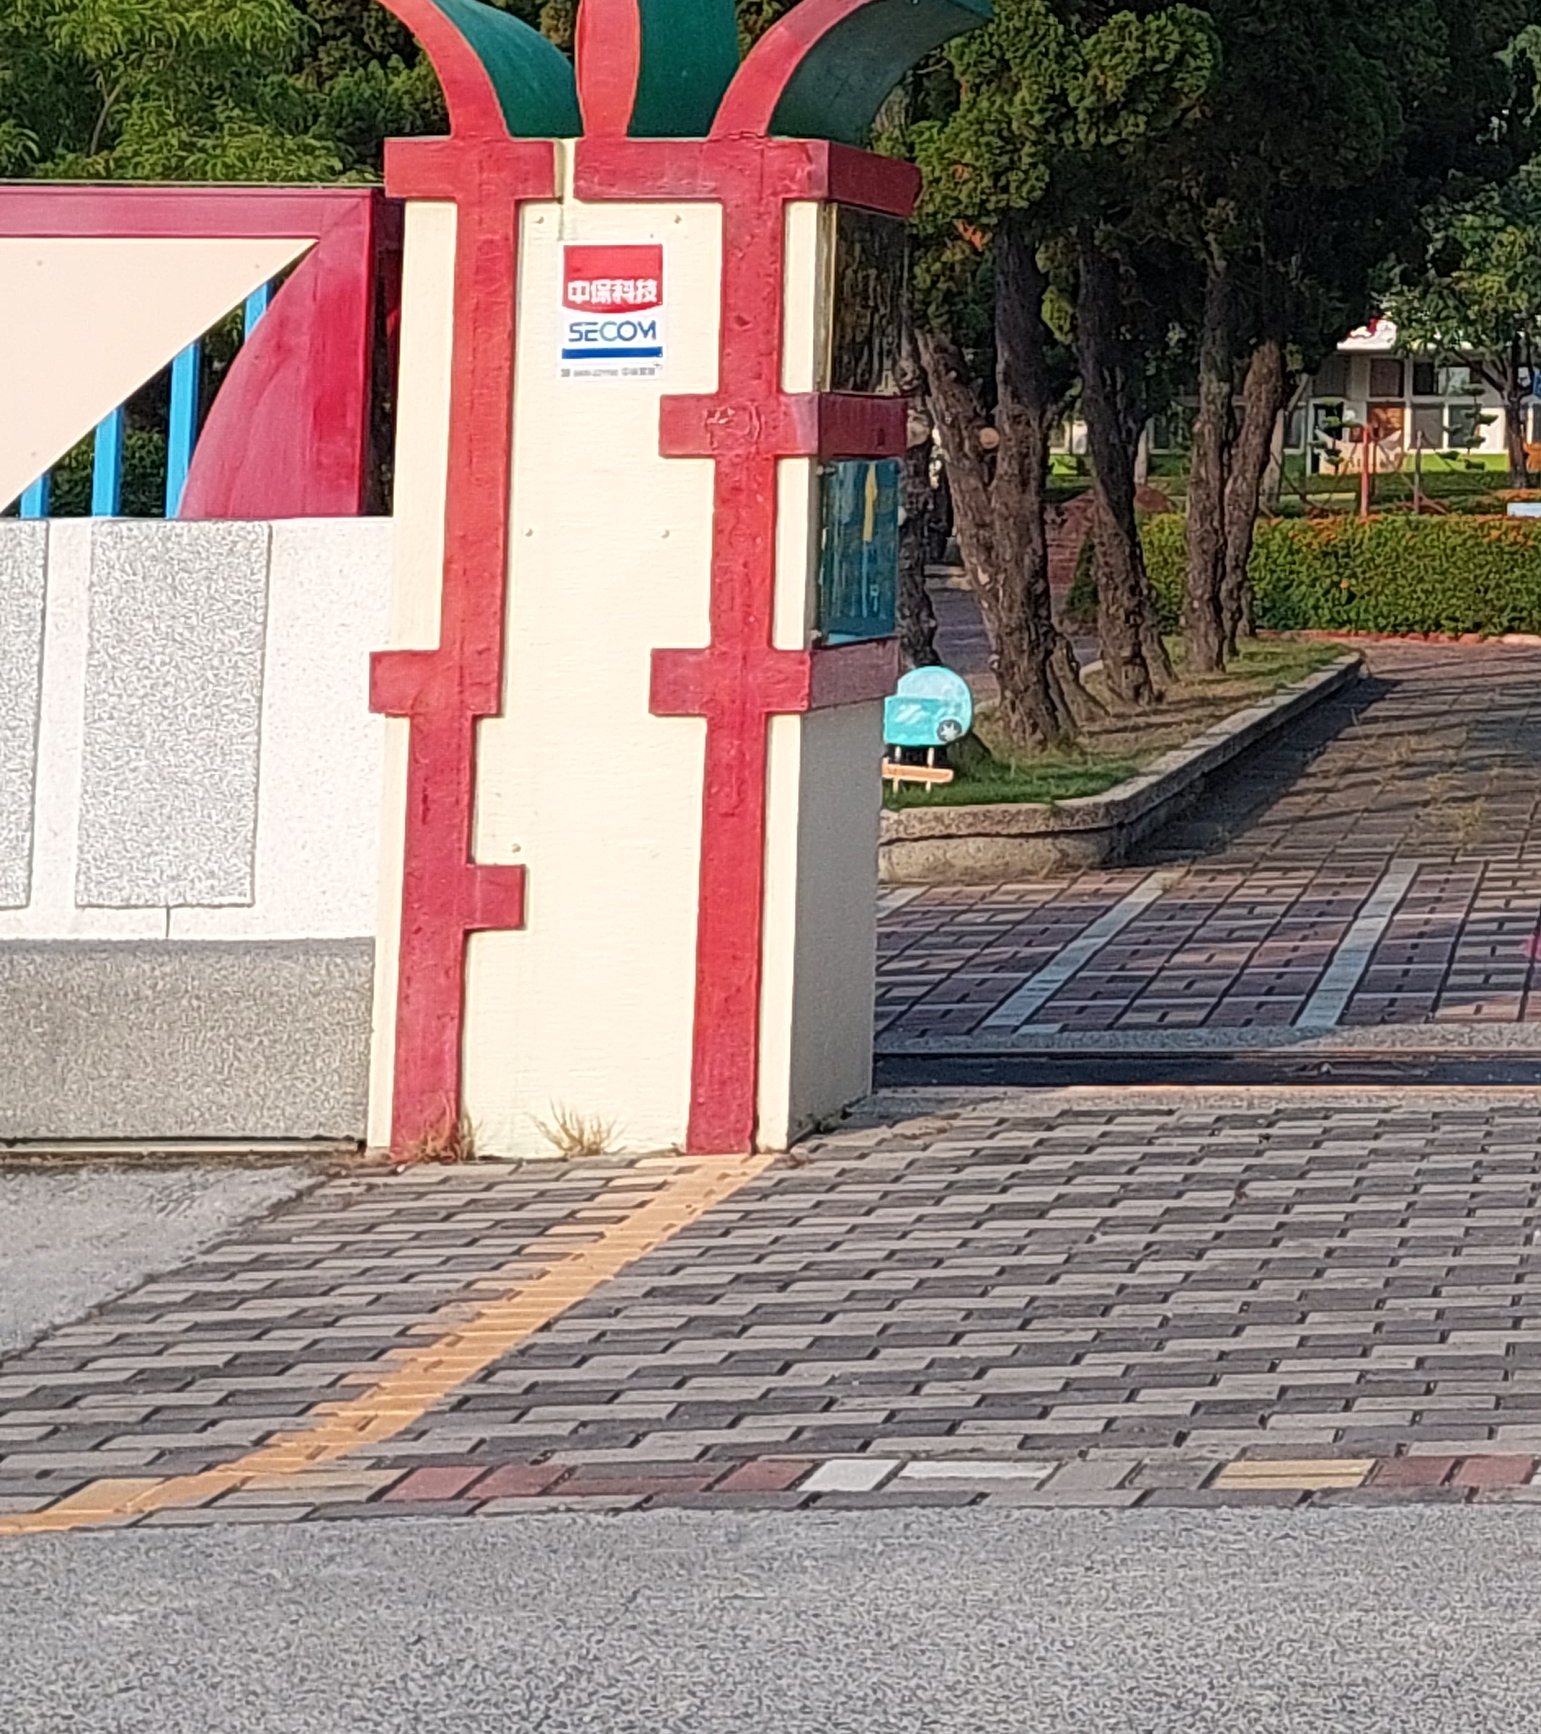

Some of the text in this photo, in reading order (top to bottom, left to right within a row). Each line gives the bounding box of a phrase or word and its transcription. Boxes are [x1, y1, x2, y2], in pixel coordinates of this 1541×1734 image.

[567, 278, 658, 305] 中保科技
[568, 320, 658, 343] SECOM
